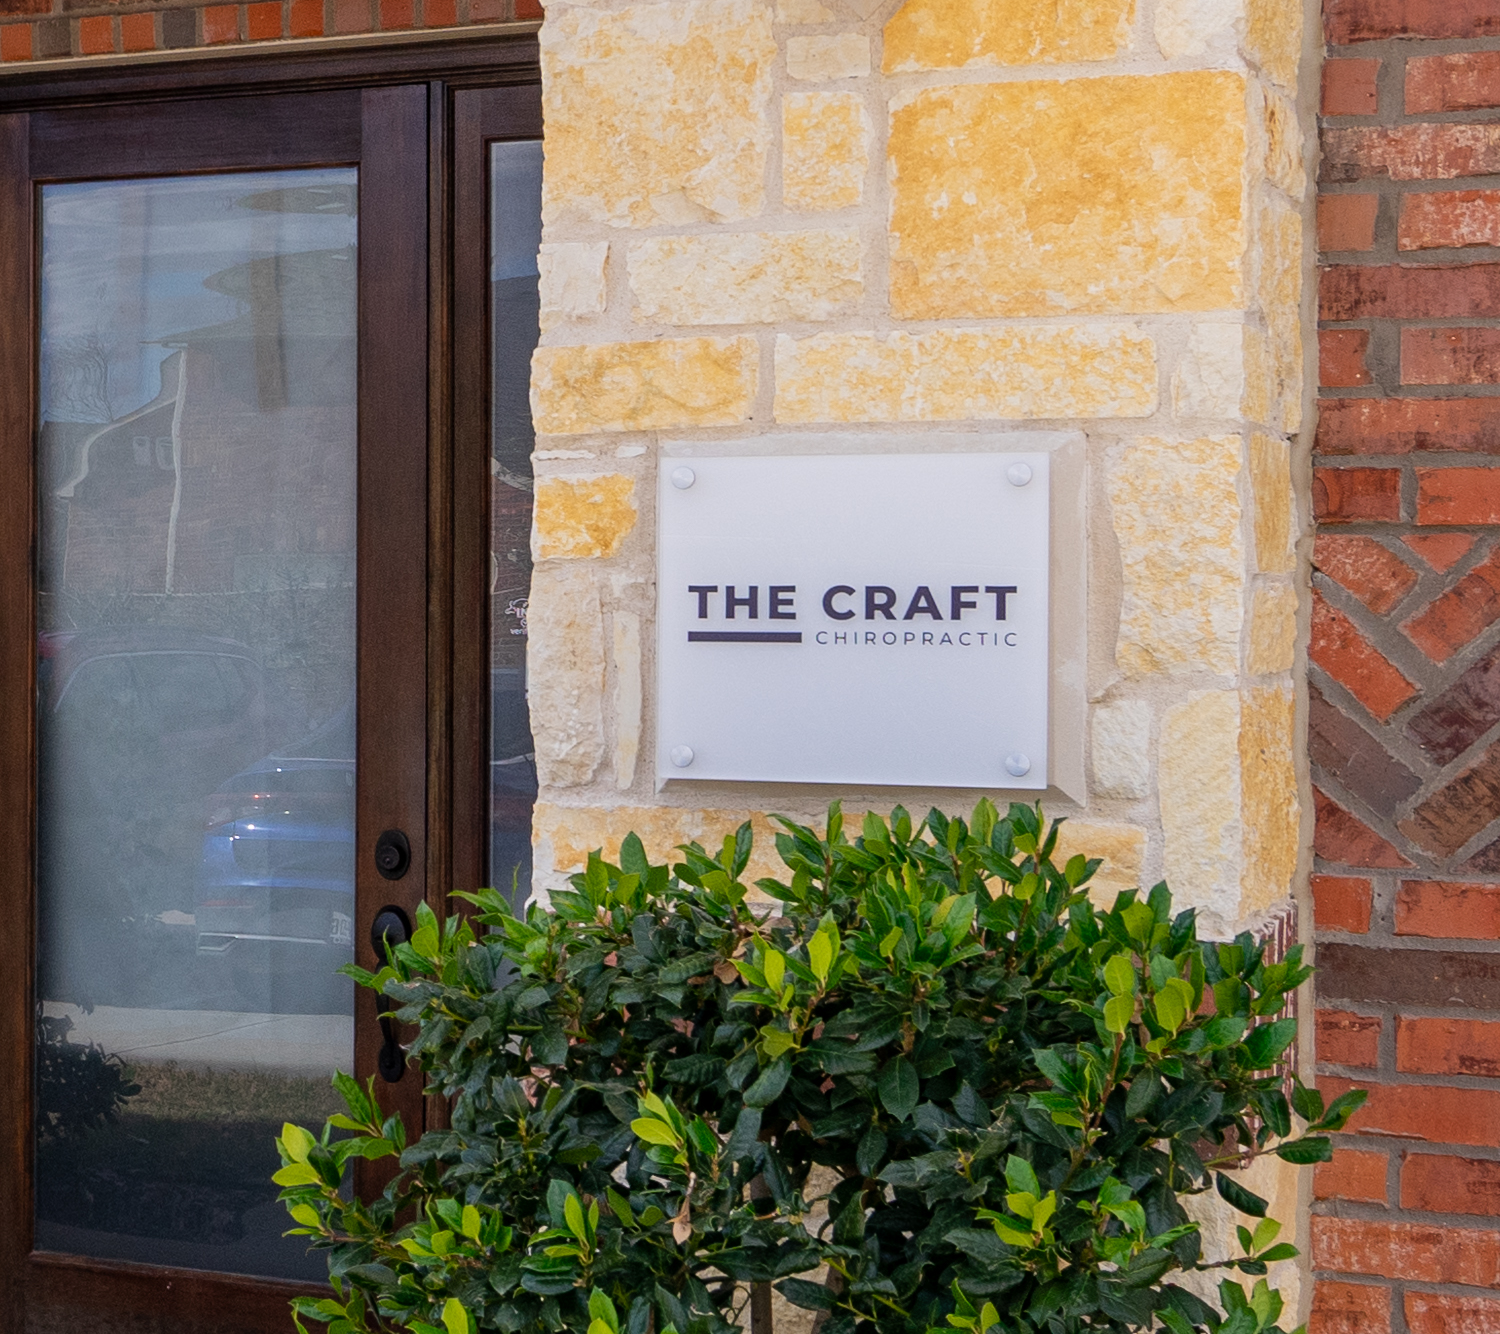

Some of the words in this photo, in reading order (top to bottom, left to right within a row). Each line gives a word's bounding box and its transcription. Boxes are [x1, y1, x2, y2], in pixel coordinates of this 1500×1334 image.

[688, 585, 797, 619] THE
[822, 585, 1018, 621] CRAFT
[815, 631, 1018, 647] CHIROPRACTIC
